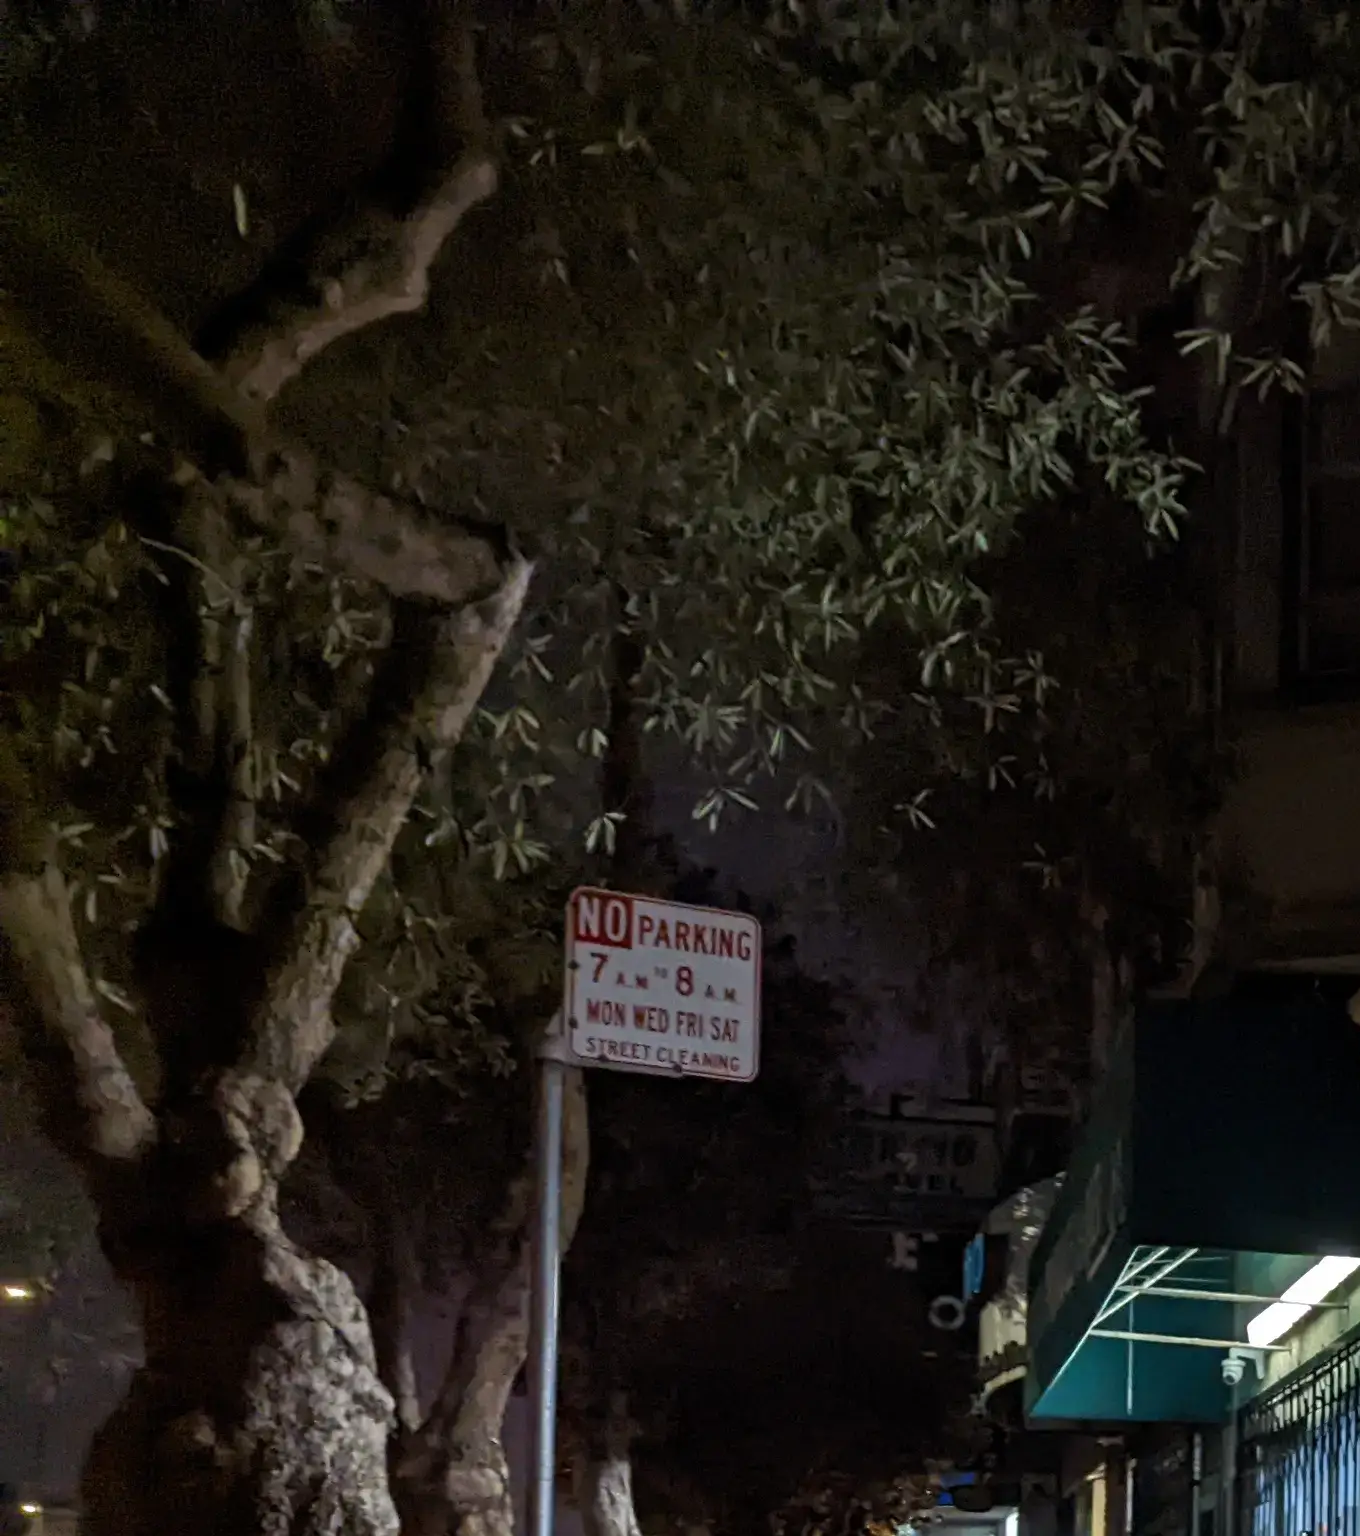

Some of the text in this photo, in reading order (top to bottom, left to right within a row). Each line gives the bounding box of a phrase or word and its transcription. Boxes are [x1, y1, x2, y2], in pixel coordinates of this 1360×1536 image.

[577, 895, 751, 961] NO PARKING
[589, 952, 609, 983] 7
[675, 965, 695, 998] 8
[586, 999, 739, 1042] MON WED FRI SAT
[586, 1037, 741, 1072] STREET CLEANING
